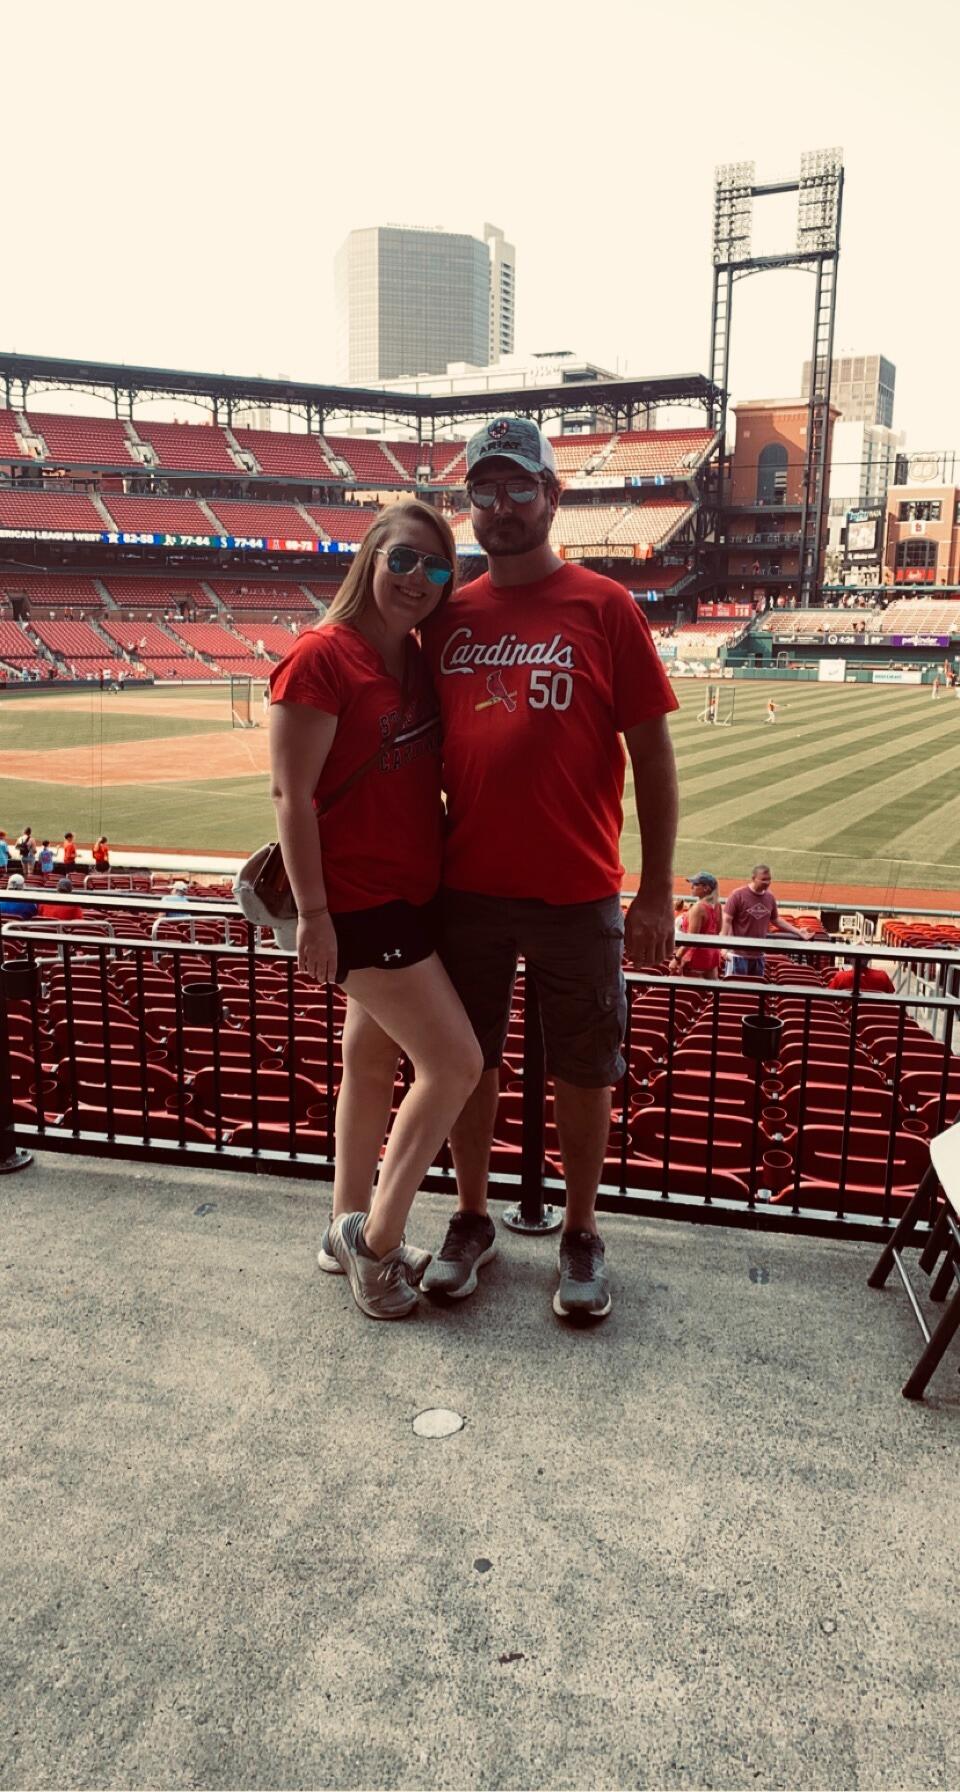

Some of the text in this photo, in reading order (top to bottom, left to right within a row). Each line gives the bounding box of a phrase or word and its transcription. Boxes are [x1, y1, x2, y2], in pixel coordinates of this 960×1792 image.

[479, 441, 522, 457] ARIAT
[36, 531, 74, 542] LEAGUE
[74, 533, 101, 543] WEST
[566, 546, 633, 558] BIG MAC LAND
[440, 627, 575, 675] Cardinals
[528, 669, 574, 711] 50
